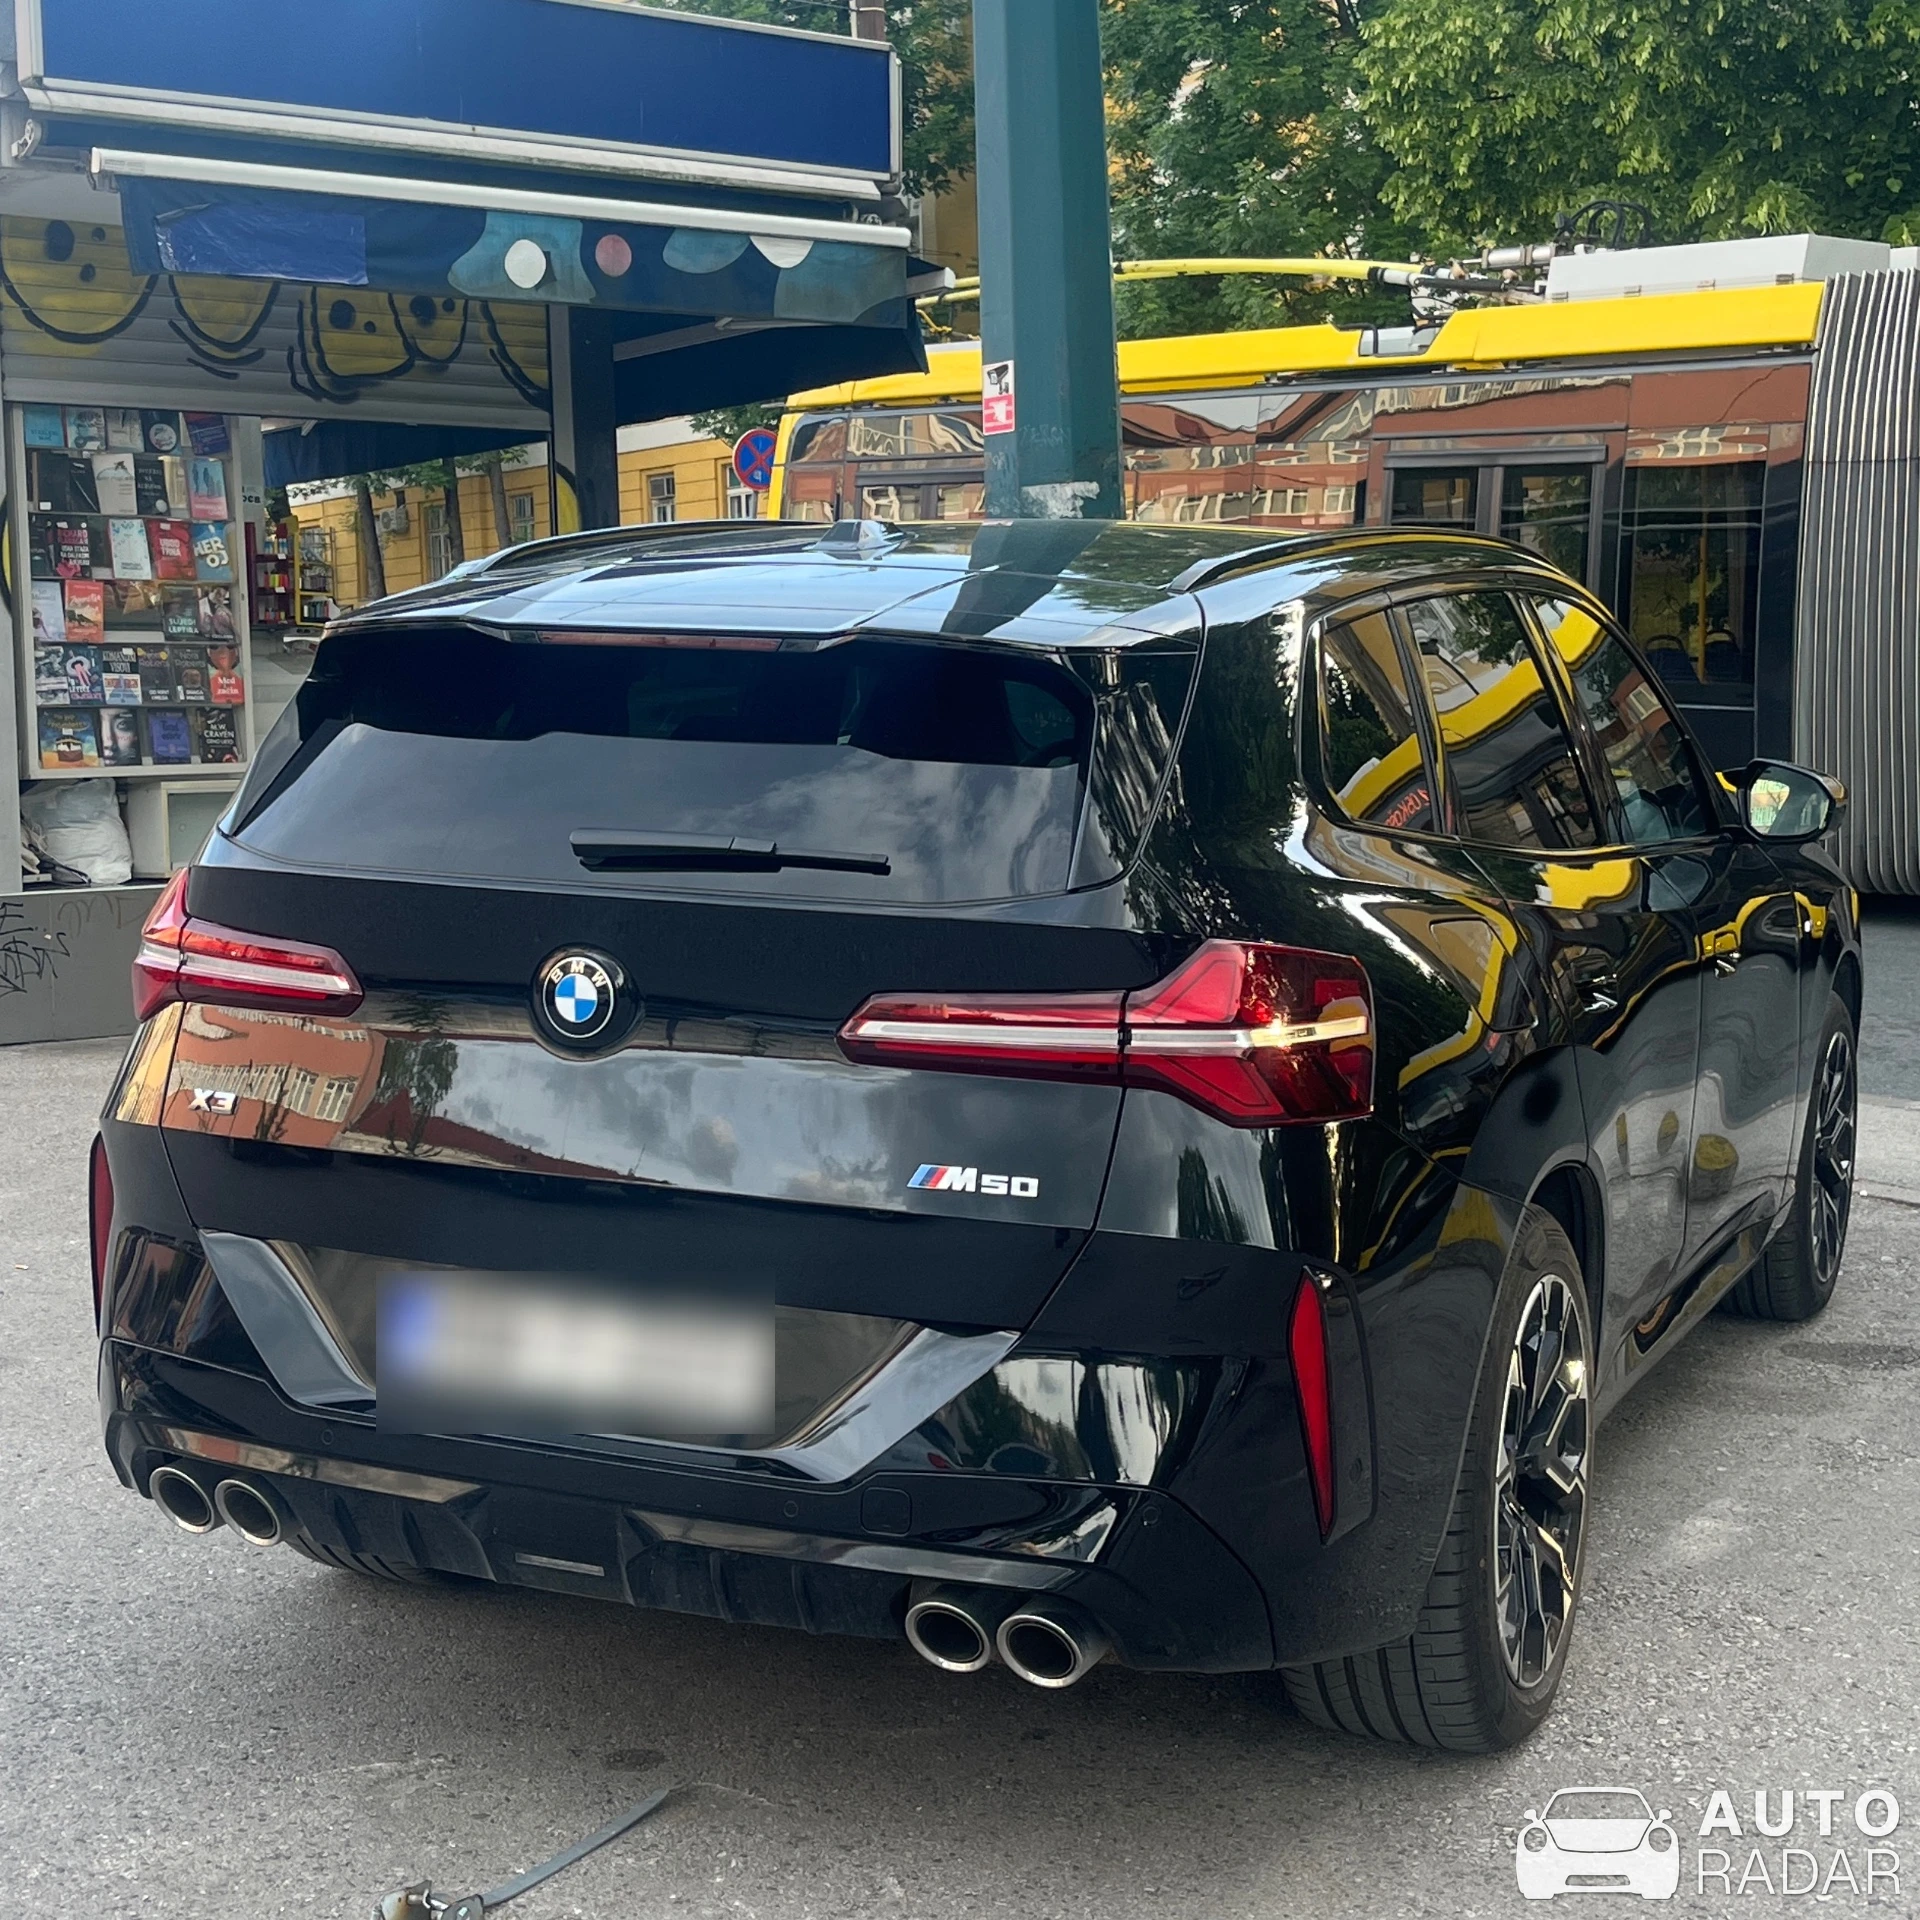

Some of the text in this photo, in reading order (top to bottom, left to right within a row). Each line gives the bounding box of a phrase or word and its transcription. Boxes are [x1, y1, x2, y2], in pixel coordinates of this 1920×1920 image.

[203, 730, 234, 738] CRAVEN
[550, 960, 607, 987] BMW
[188, 1088, 237, 1115] X3
[935, 1165, 1039, 1198] M50
